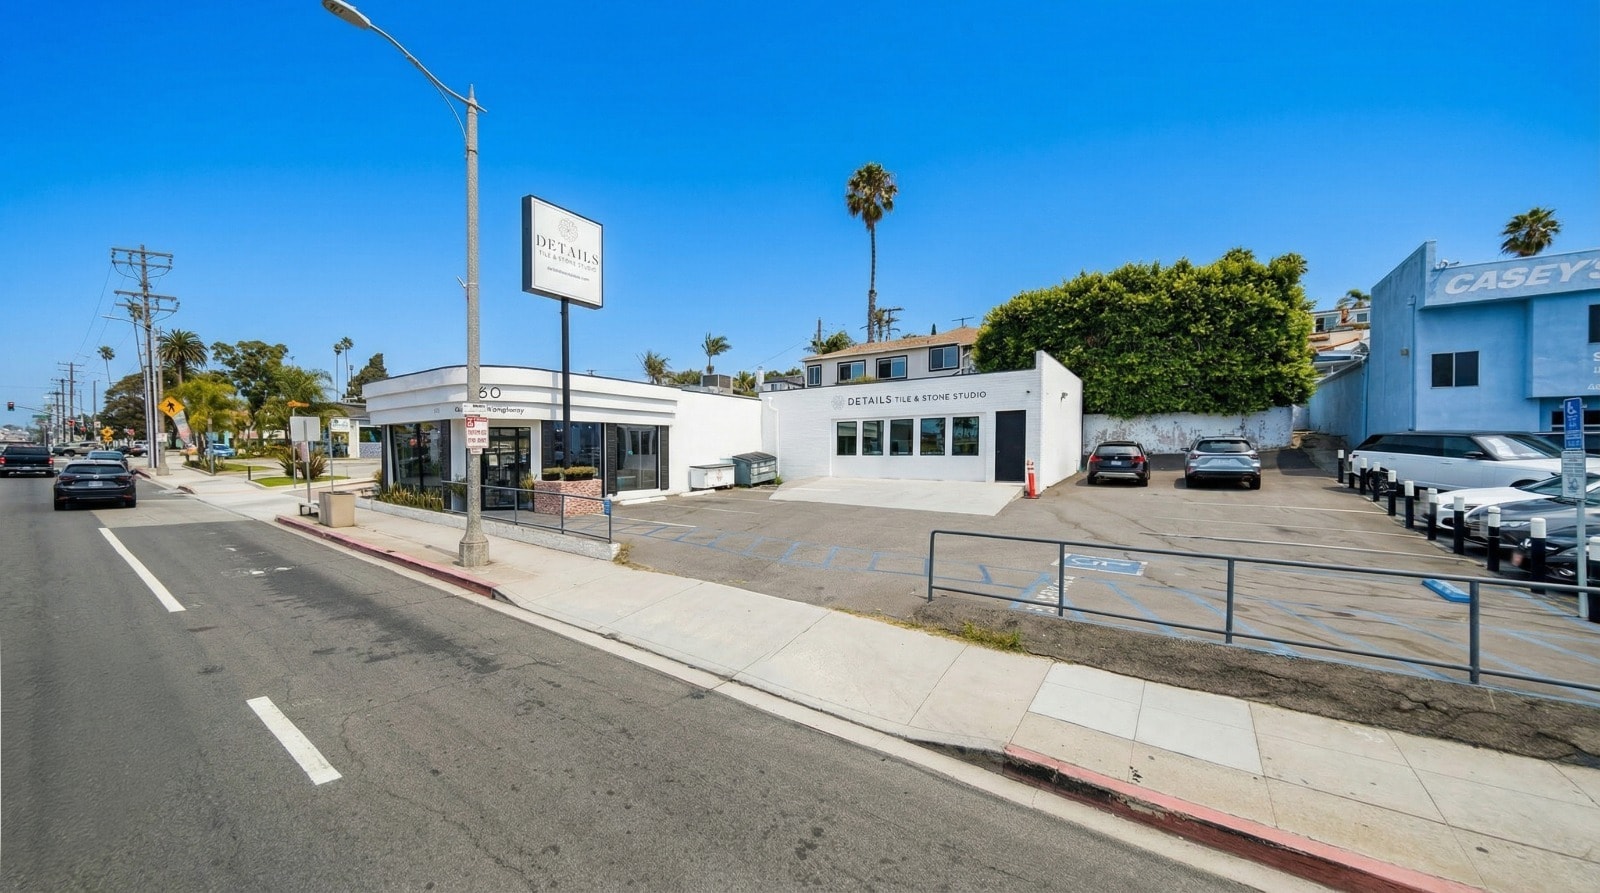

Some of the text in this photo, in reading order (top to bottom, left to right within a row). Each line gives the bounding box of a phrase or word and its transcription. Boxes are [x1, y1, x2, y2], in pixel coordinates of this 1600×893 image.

[536, 234, 599, 266] DETAILS
[539, 249, 551, 259] TILE
[558, 255, 576, 267] STONE
[578, 262, 597, 273] STUDIO
[847, 395, 892, 406] DETAILS
[894, 395, 912, 403] TILE
[922, 393, 950, 402] STONE
[953, 391, 987, 400] STUDIO
